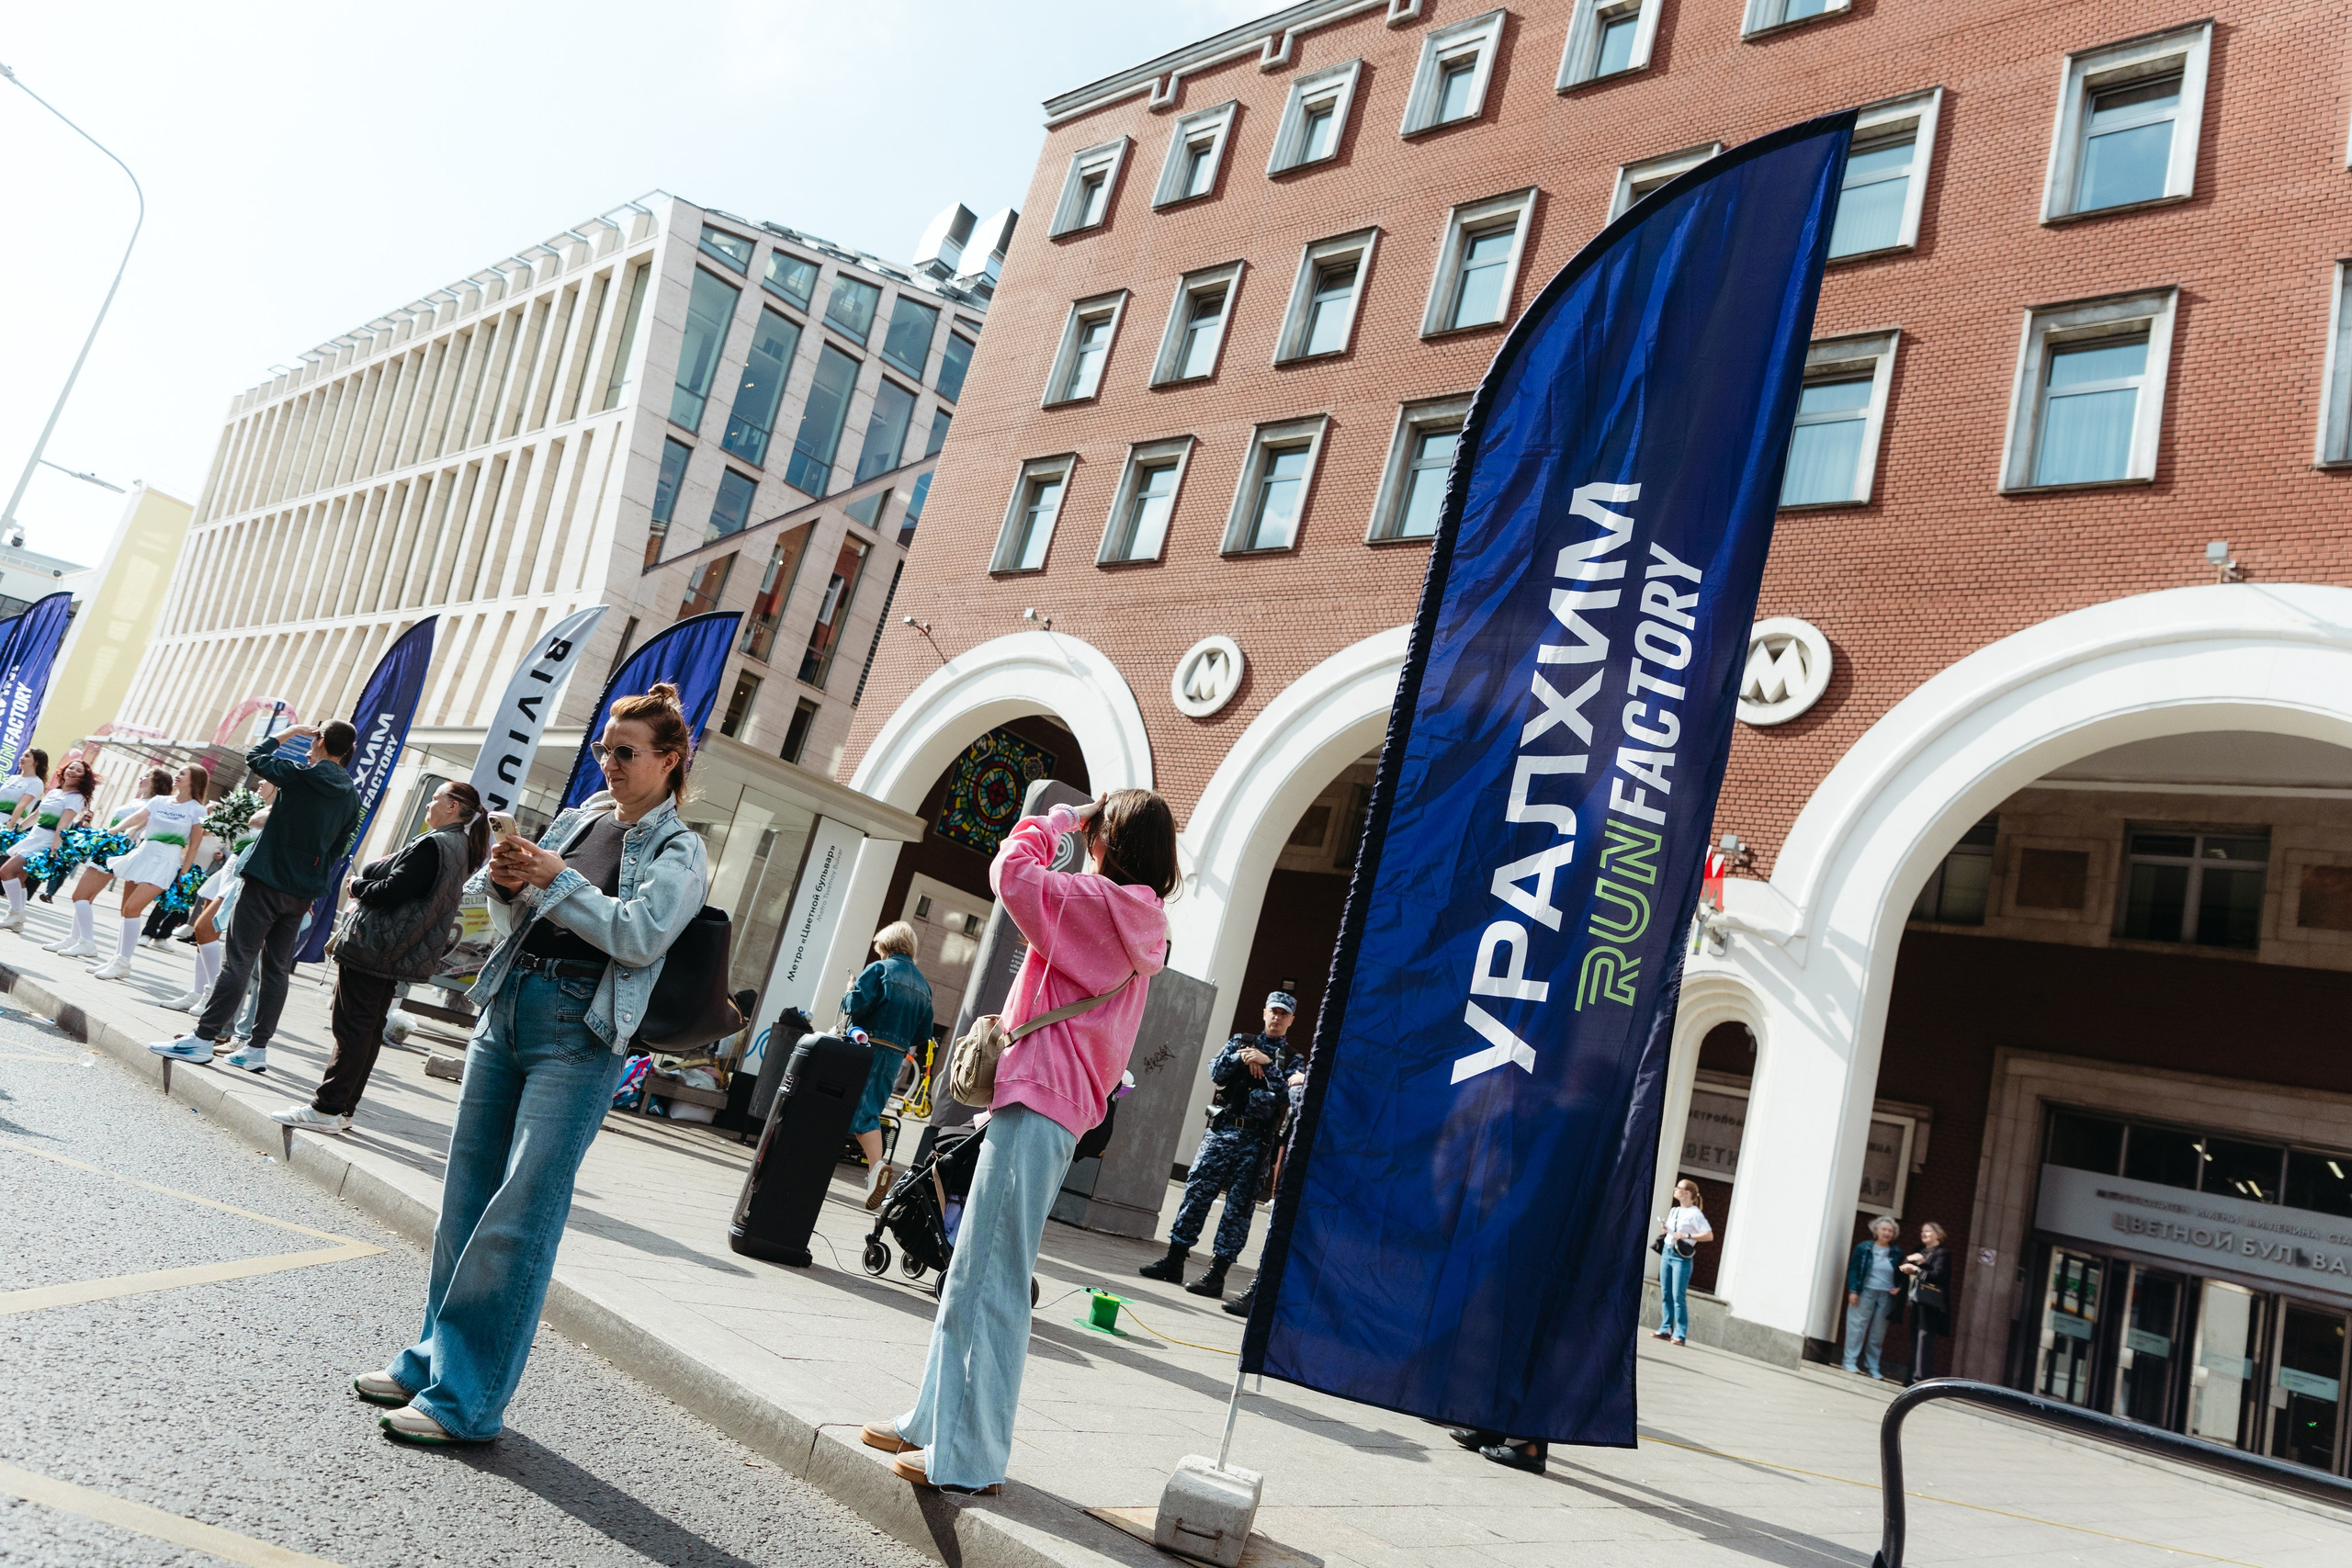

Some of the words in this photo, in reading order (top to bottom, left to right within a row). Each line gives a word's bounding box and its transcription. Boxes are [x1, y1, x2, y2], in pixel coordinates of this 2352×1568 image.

[1451, 481, 1643, 1086] УРАЛХИМ
[787, 946, 804, 982] Метро
[800, 894, 820, 943] «Цветной
[816, 845, 835, 892] бульвар»
[817, 901, 827, 921] Metro
[823, 871, 837, 898] Tsvetnoy
[832, 848, 843, 870] Bulvar
[2112, 1211, 2234, 1253] ЦВЕТНОЙ
